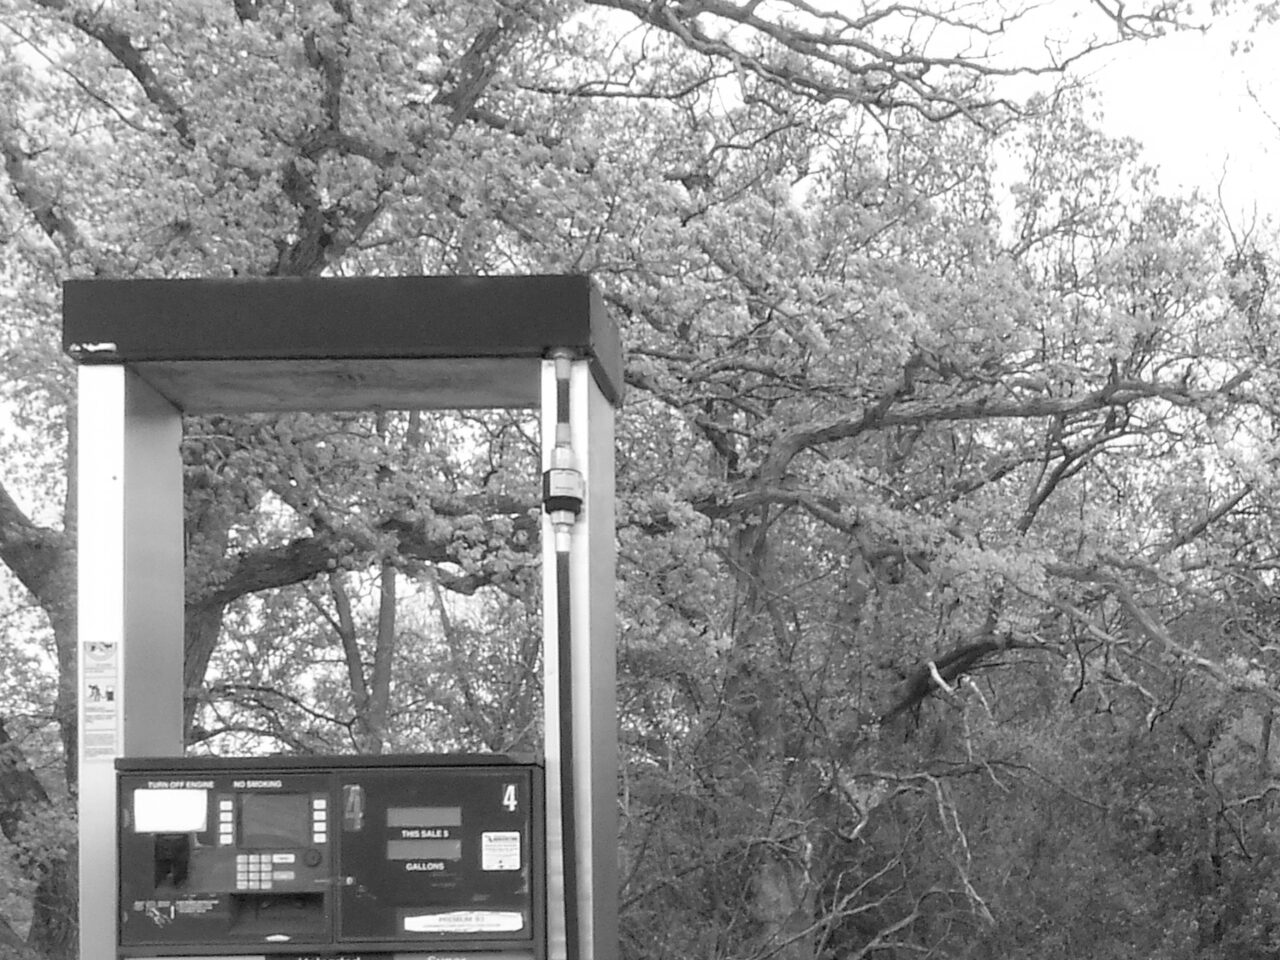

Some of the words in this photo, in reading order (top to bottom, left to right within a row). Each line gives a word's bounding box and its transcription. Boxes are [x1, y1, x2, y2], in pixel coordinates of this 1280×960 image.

[246, 780, 282, 788] SMOKING
[503, 785, 518, 811] 4
[401, 830, 419, 838] THIS
[421, 830, 441, 838] SALE
[406, 863, 445, 871] GALLONS
